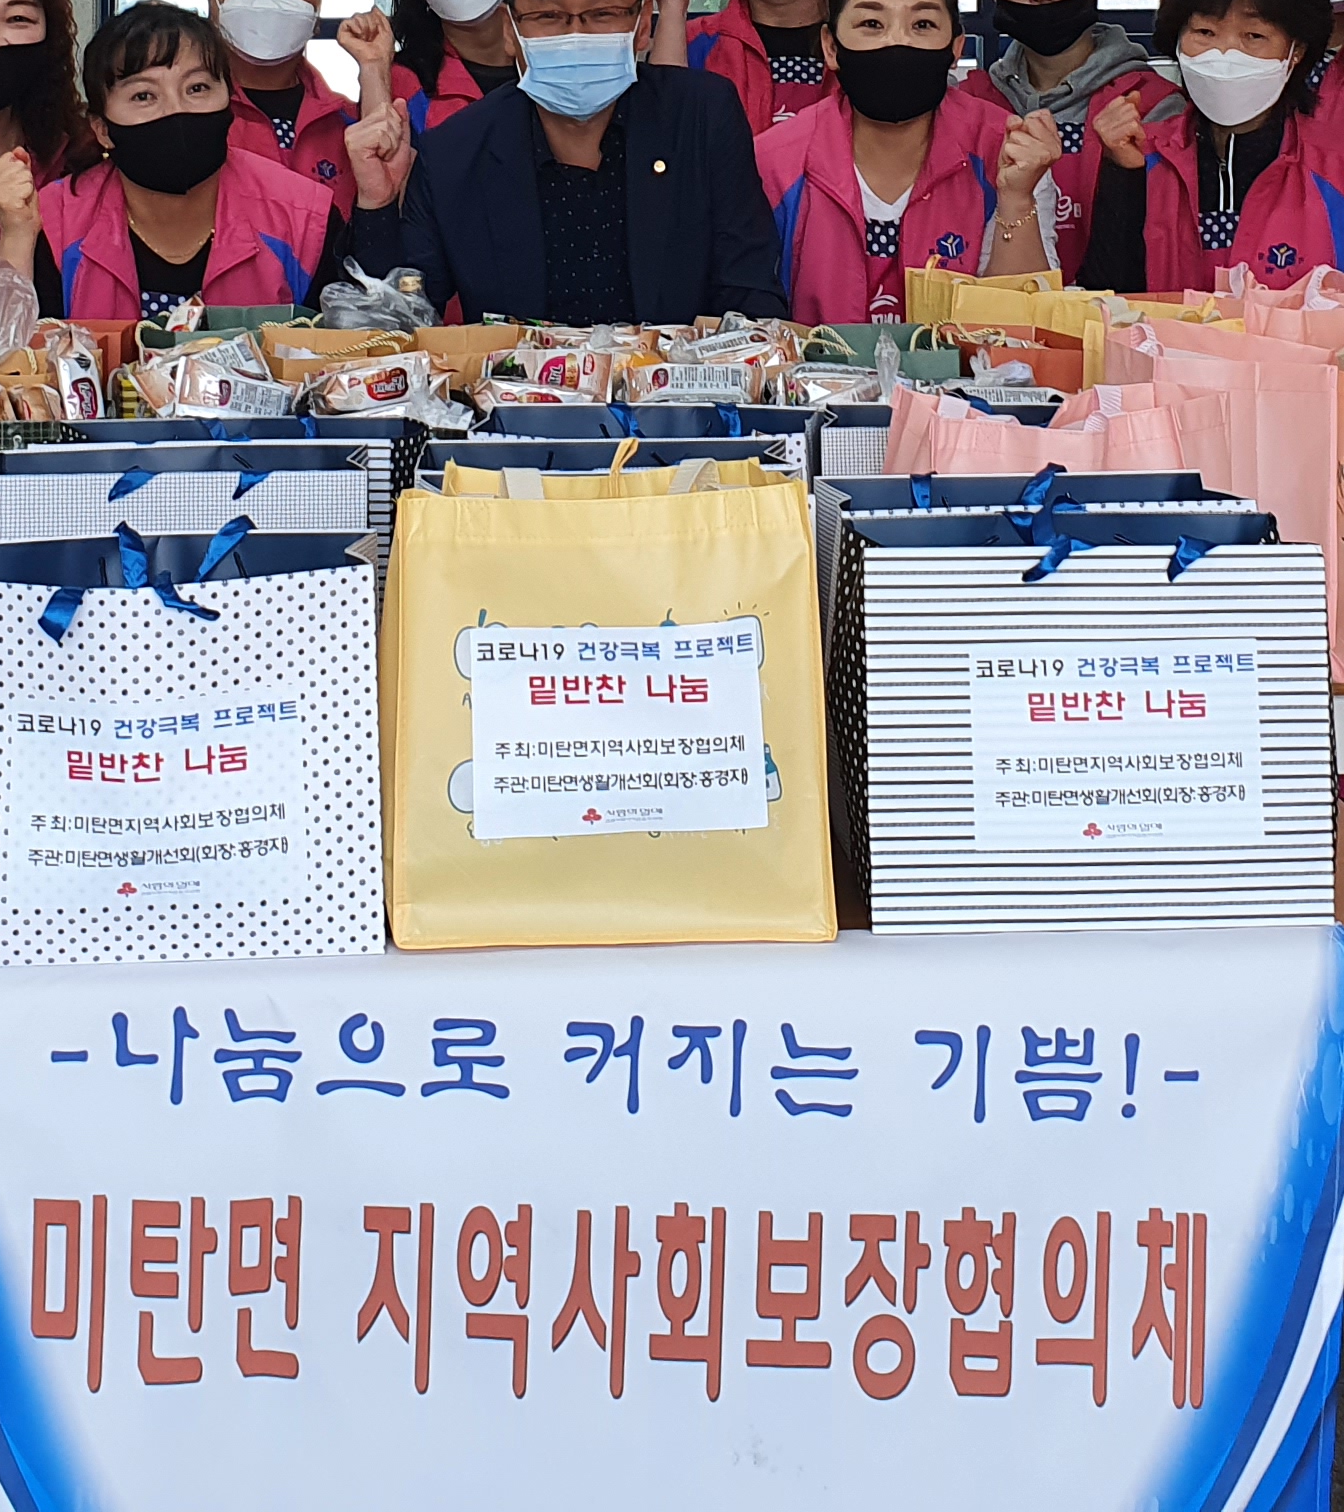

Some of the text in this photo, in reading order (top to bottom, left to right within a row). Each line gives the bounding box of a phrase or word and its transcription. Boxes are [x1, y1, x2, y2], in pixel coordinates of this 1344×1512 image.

[477, 633, 753, 661] 코로나19 건강극복 프로젝트
[976, 654, 1254, 678] 코로나19 건강극복 프로젝트
[529, 674, 708, 705] 밑반찬 나눔
[1028, 689, 1206, 722] 밑반찬 나눔
[17, 701, 298, 740] 코로나19 건강극복 프로젝트
[67, 744, 247, 783] 밑반찬 나눔
[564, 1016, 859, 1117] 커지는
[30, 1194, 1210, 1410] 미탄면 지역사회보장협의체
